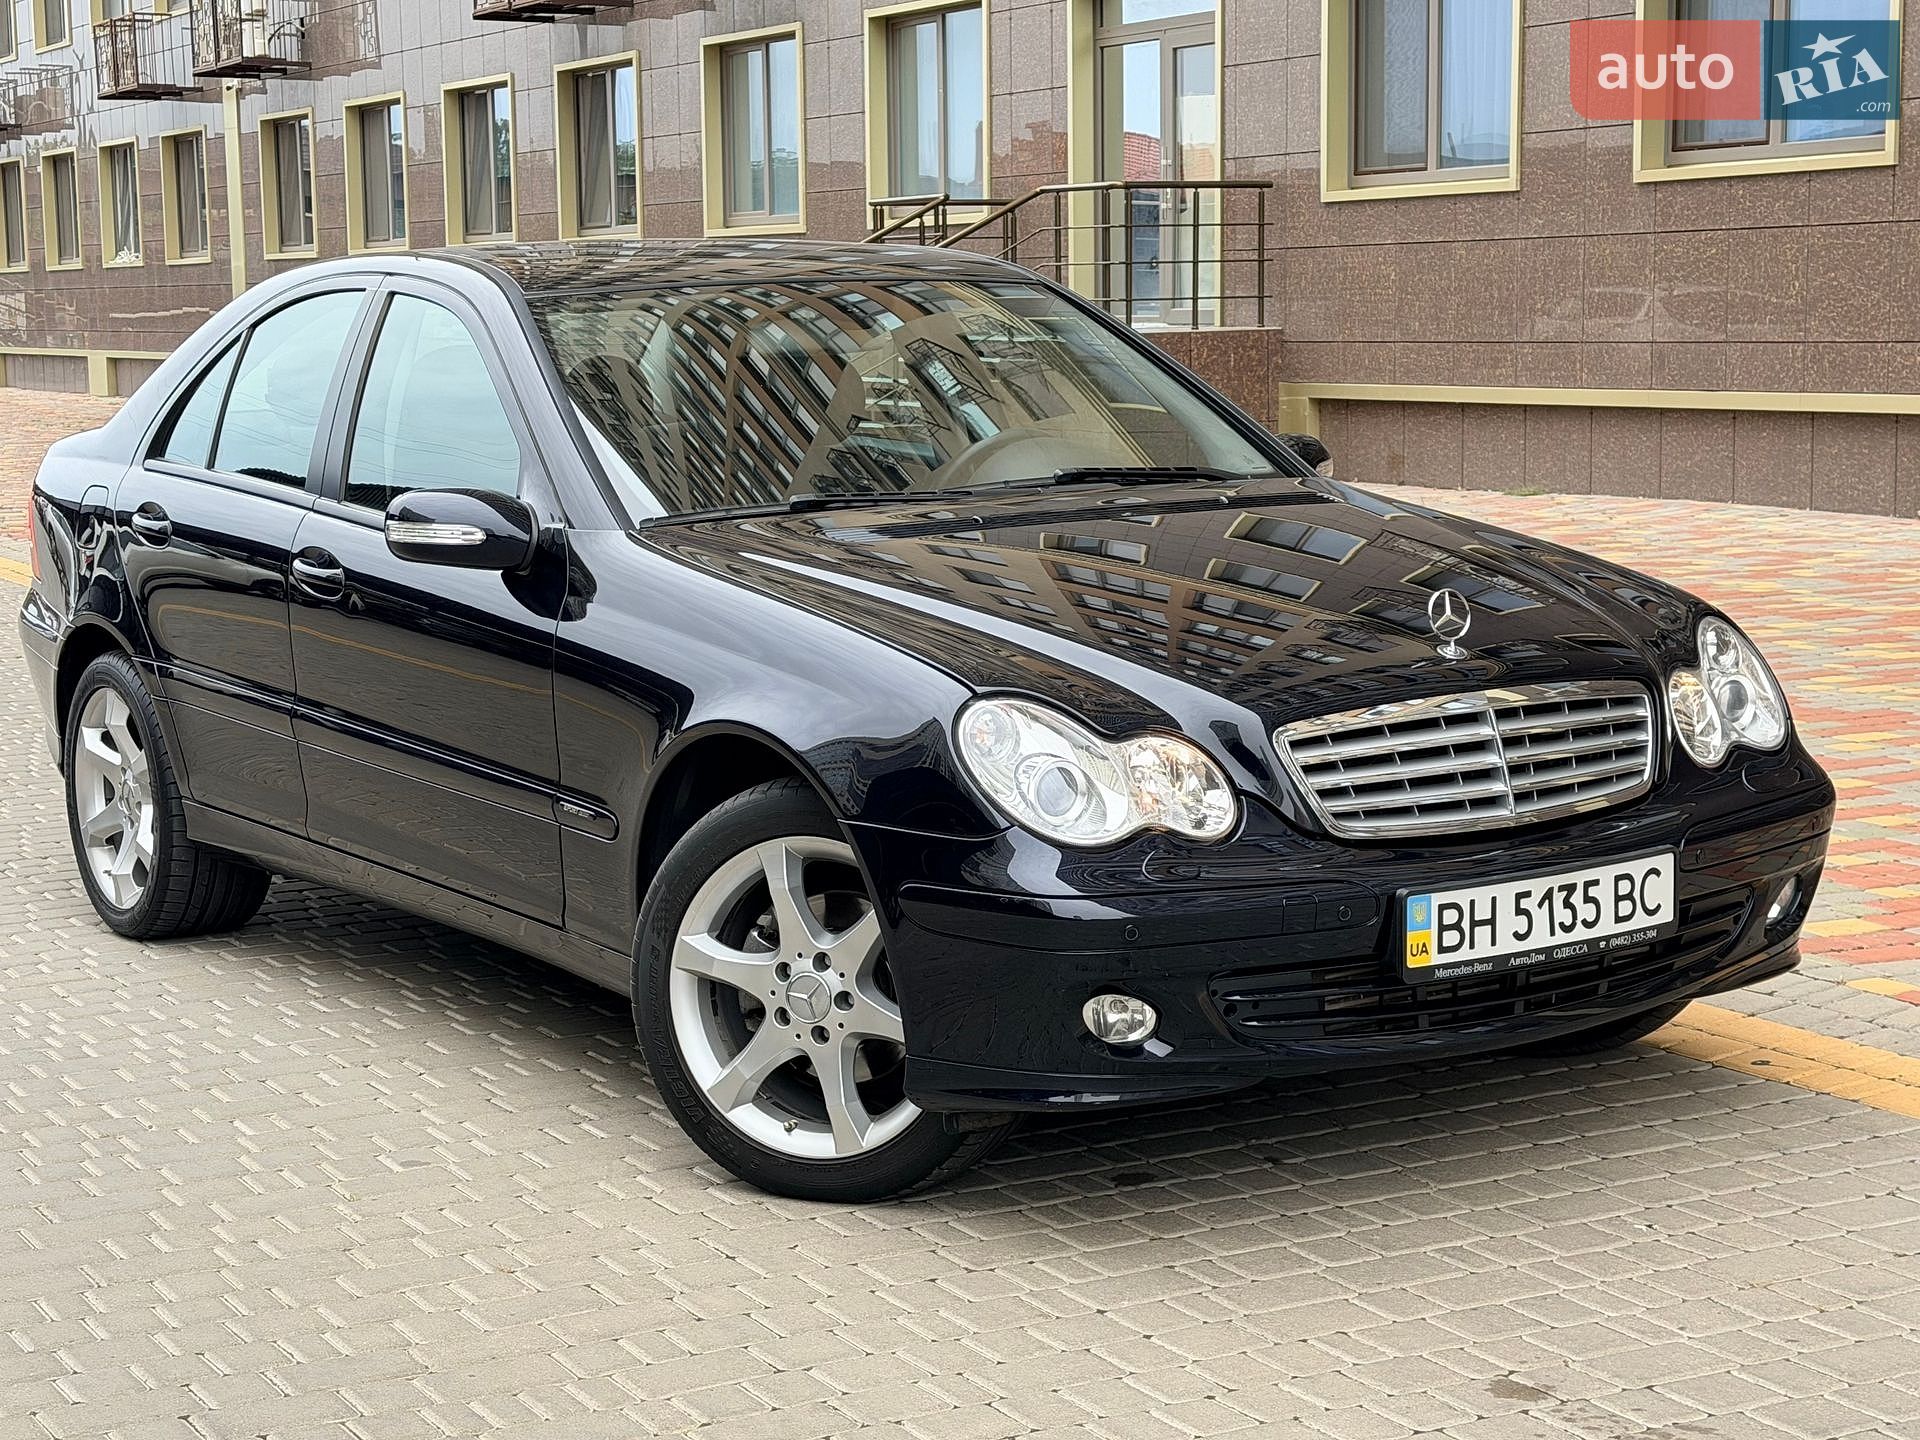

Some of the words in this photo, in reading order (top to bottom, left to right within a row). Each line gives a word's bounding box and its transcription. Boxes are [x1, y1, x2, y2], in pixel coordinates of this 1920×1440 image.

[1437, 896, 1498, 955] BH
[1512, 878, 1600, 942] 5135
[1614, 867, 1662, 925] BC
[1410, 943, 1429, 957] UA
[1508, 952, 1546, 966] АвтоДом
[1553, 944, 1588, 958] ОДЕССА
[1434, 961, 1493, 979] Mercedes-Benz
